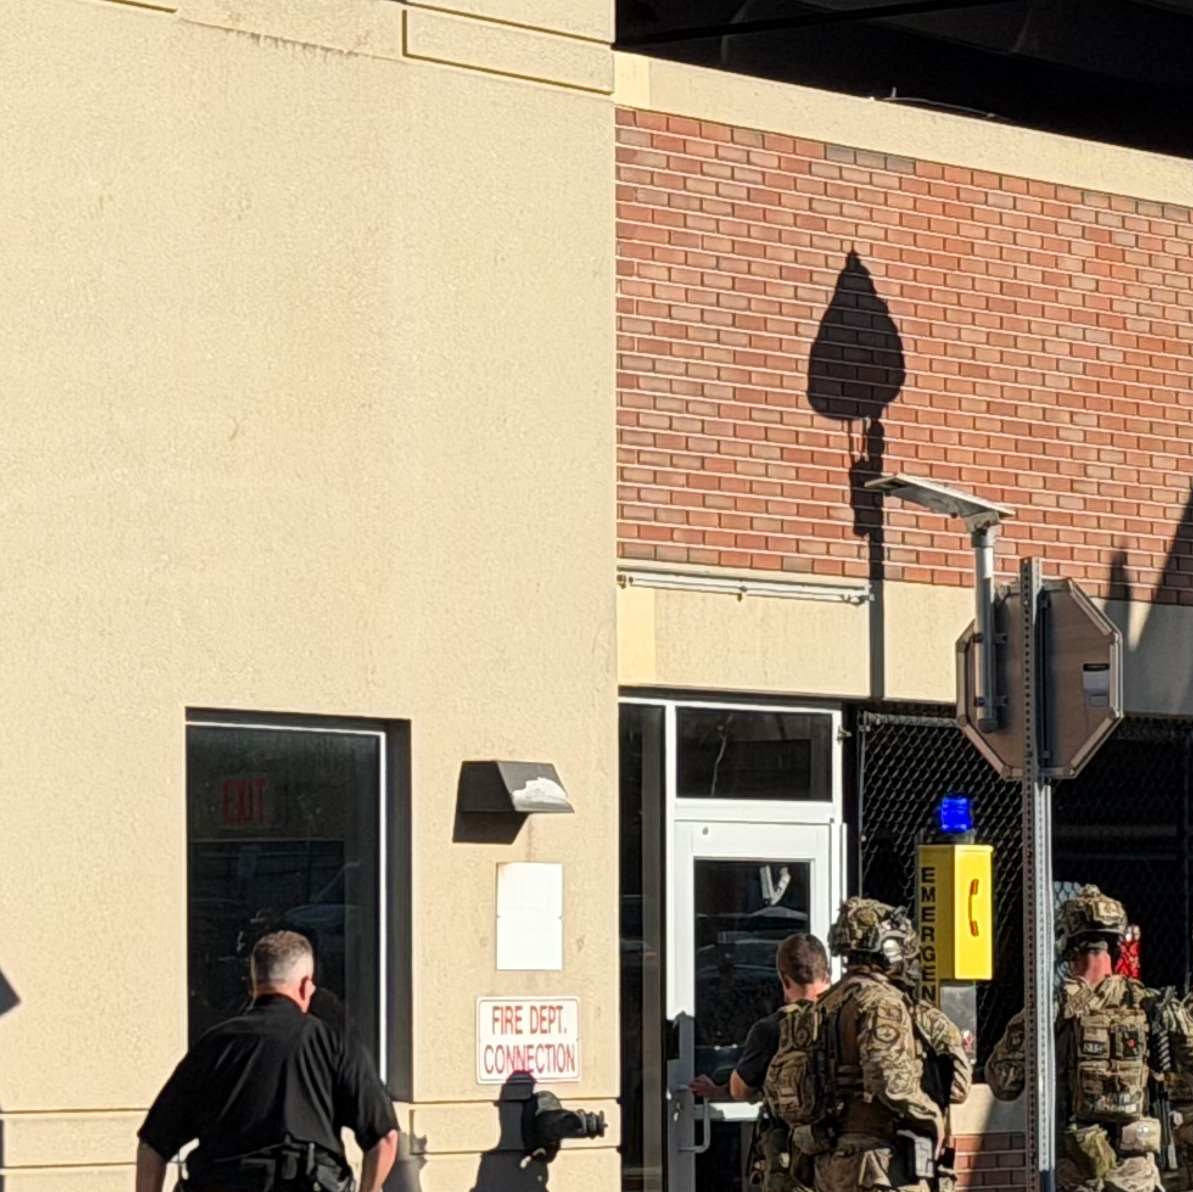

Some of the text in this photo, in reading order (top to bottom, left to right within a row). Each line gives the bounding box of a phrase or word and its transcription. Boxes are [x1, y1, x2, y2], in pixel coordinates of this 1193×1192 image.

[223, 777, 268, 823] EXIT
[920, 866, 937, 1003] EMERGEN
[491, 1004, 568, 1036] FIRE DEPT.
[483, 1042, 576, 1075] CONNECTION
